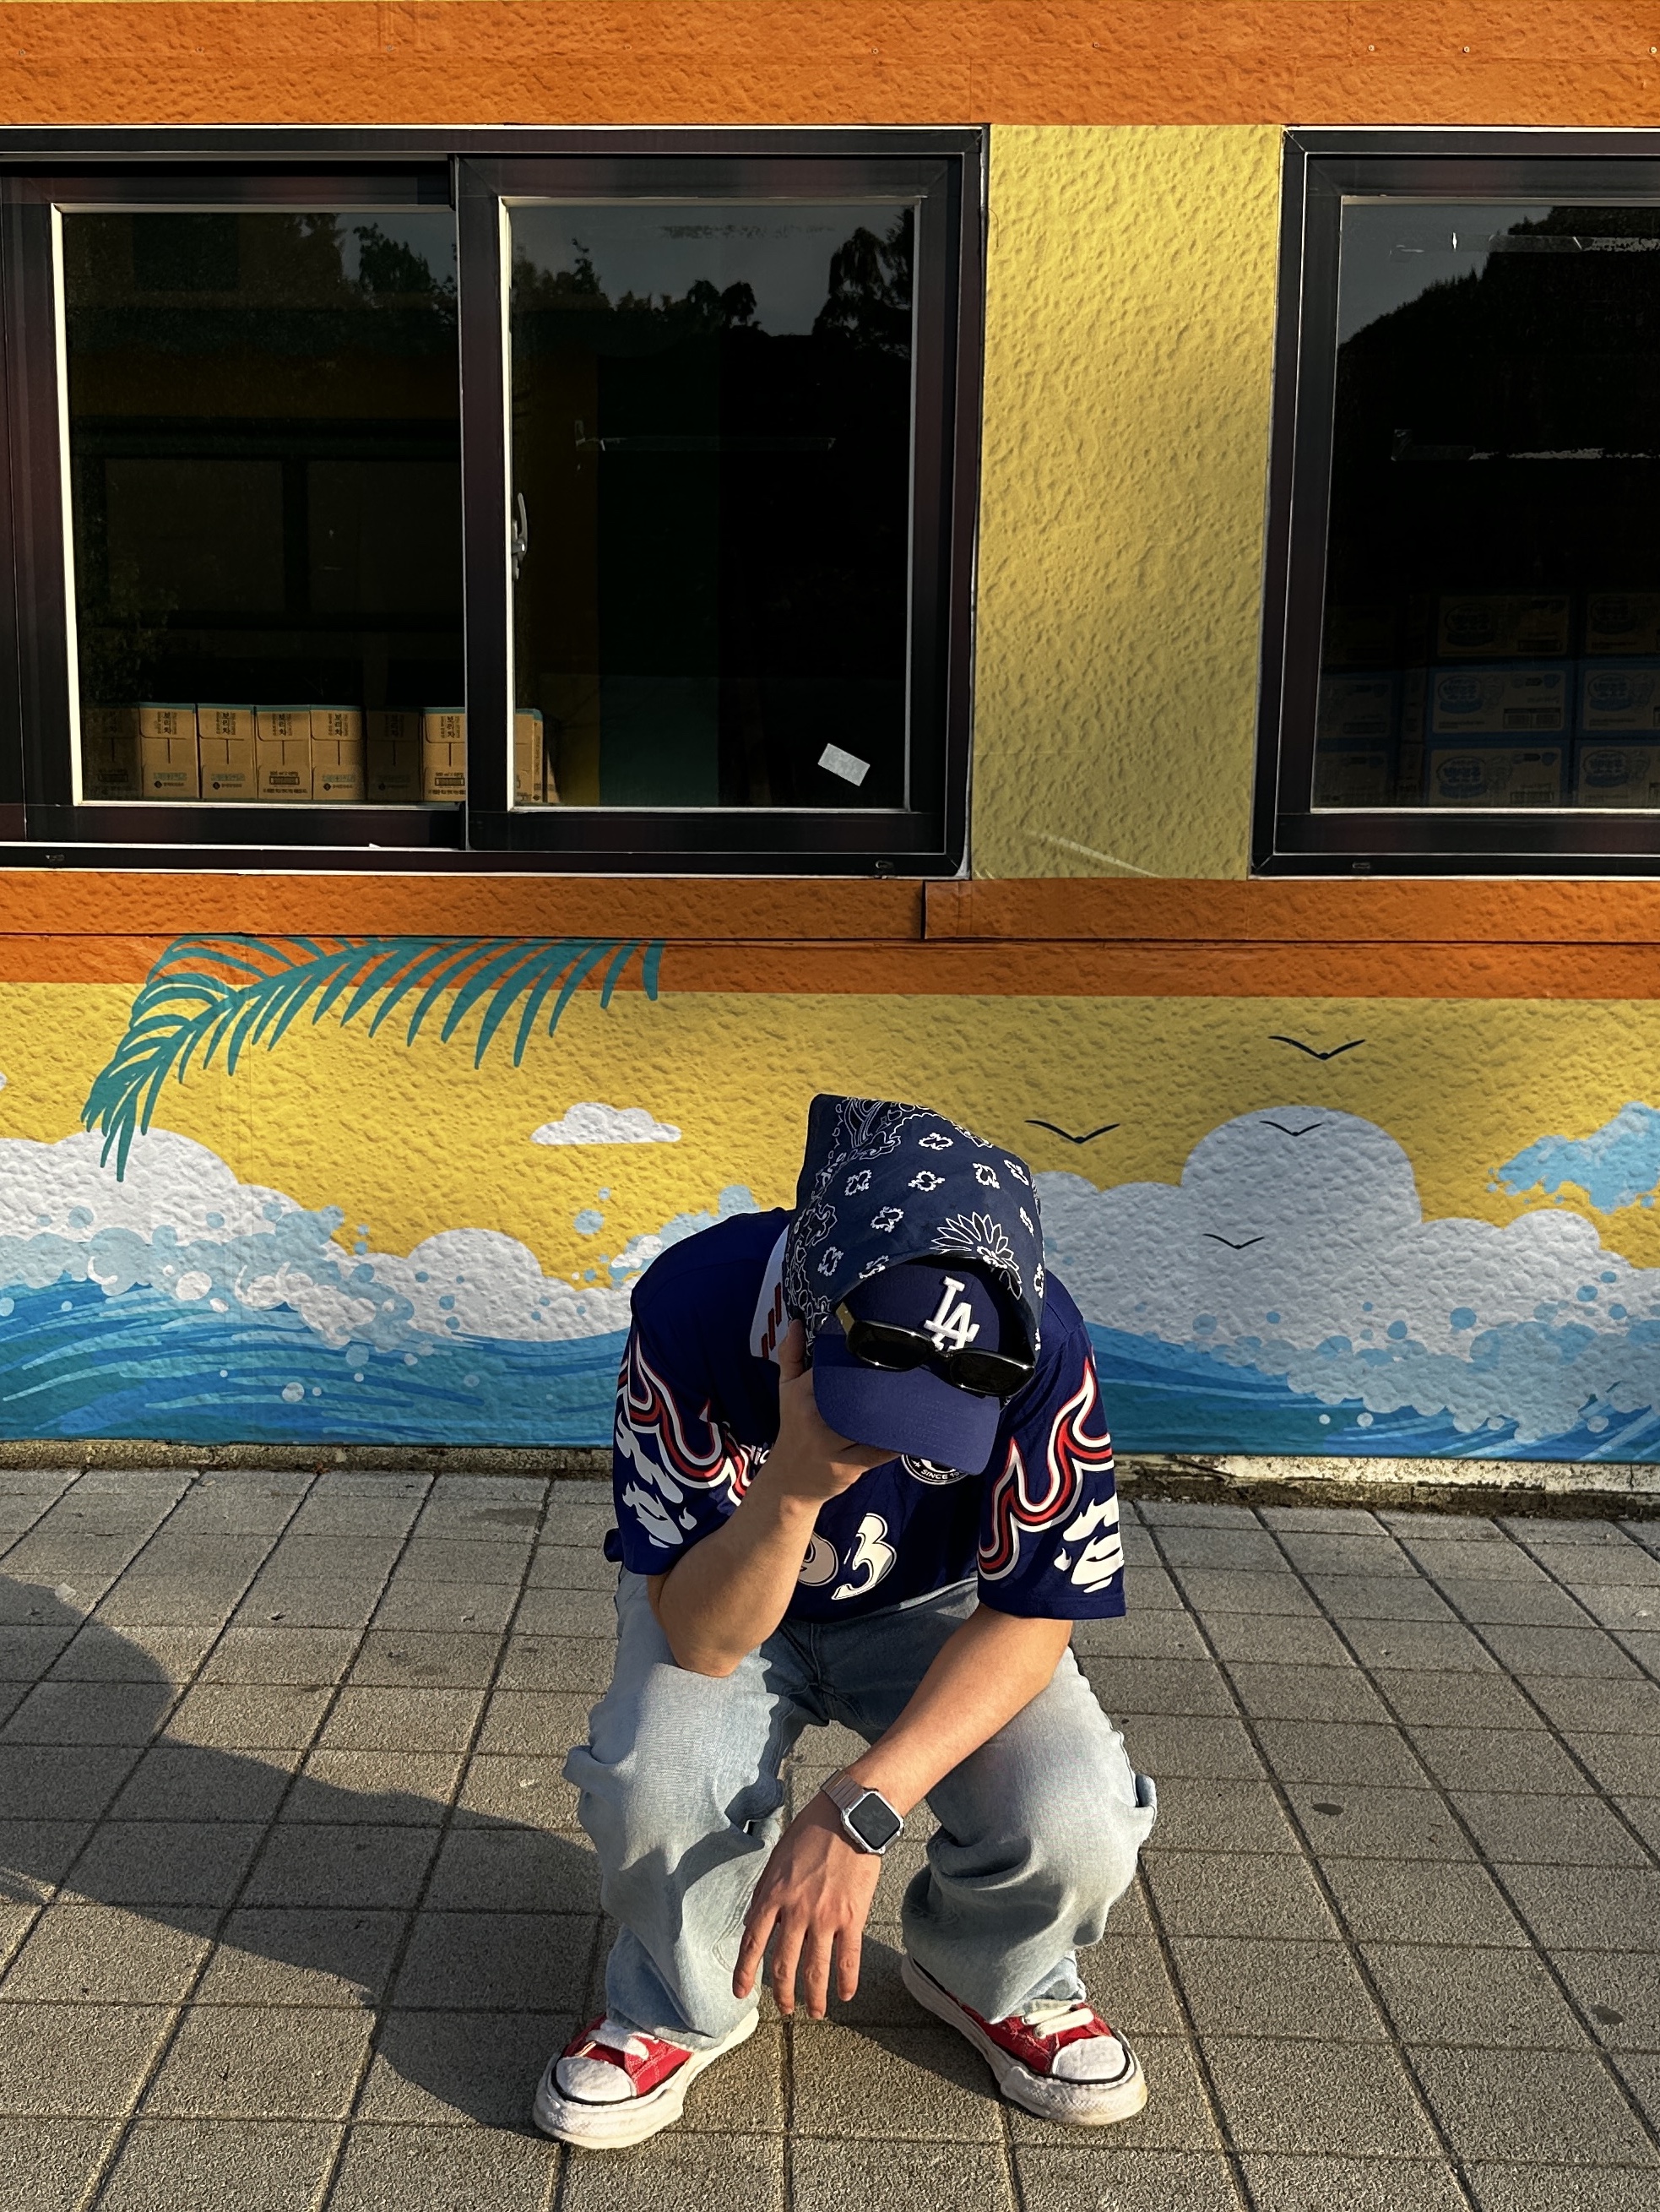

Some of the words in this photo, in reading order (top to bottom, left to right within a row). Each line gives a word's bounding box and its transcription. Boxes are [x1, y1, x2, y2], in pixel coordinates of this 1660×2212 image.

[447, 716, 455, 738] 보리차
[923, 1275, 980, 1351] LA
[921, 1469, 948, 1480] SINCE
